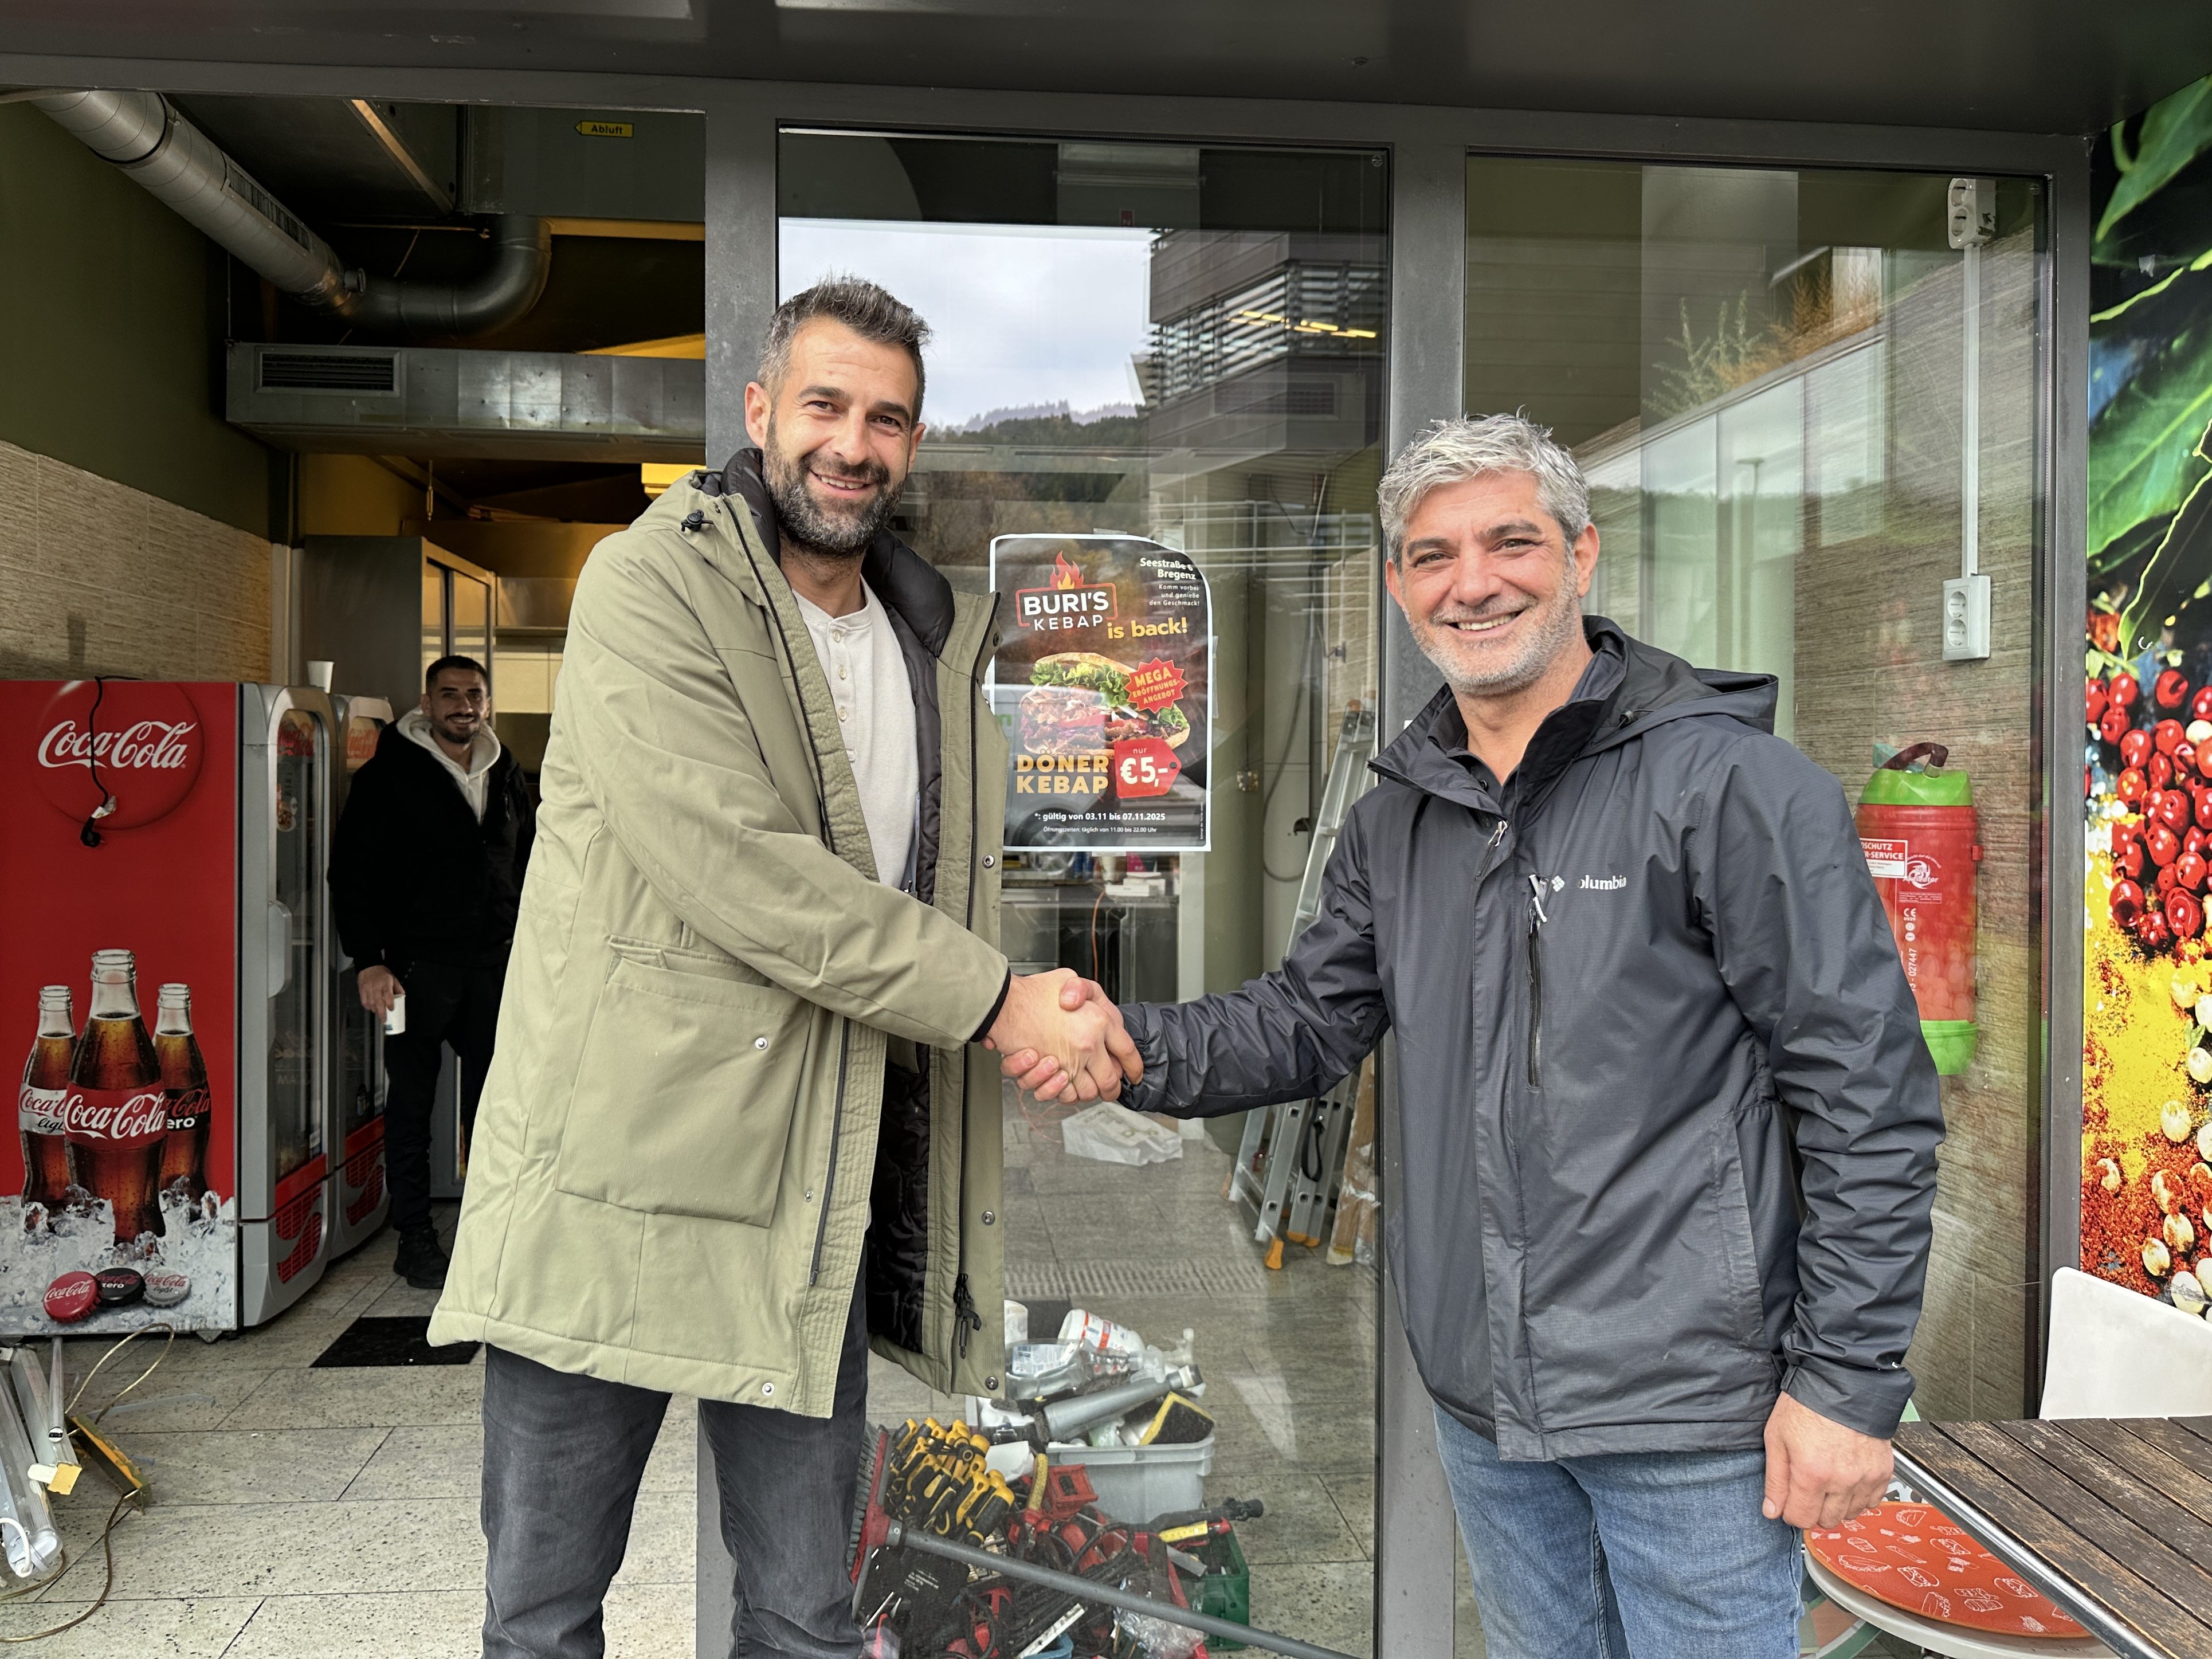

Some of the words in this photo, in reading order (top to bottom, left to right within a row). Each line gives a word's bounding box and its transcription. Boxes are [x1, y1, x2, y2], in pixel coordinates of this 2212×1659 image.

[591, 124, 623, 134] Abluft
[1140, 557, 1186, 570] Seestraße
[1158, 569, 1197, 581] Bregenz
[1023, 591, 1109, 616] BURI'S
[1034, 614, 1103, 632] KEBAP
[1107, 622, 1125, 639] is
[1131, 617, 1188, 637] back!
[1134, 666, 1173, 688] MEGA
[1143, 689, 1175, 705] ANGEBOT
[38, 720, 198, 769] Coca-Cola
[1017, 748, 1109, 773] DÖNER
[1017, 775, 1109, 794] KEBAP
[1043, 813, 1066, 822] gültig
[1578, 874, 1627, 890] olumbia
[64, 1092, 167, 1139] Coca-Cola
